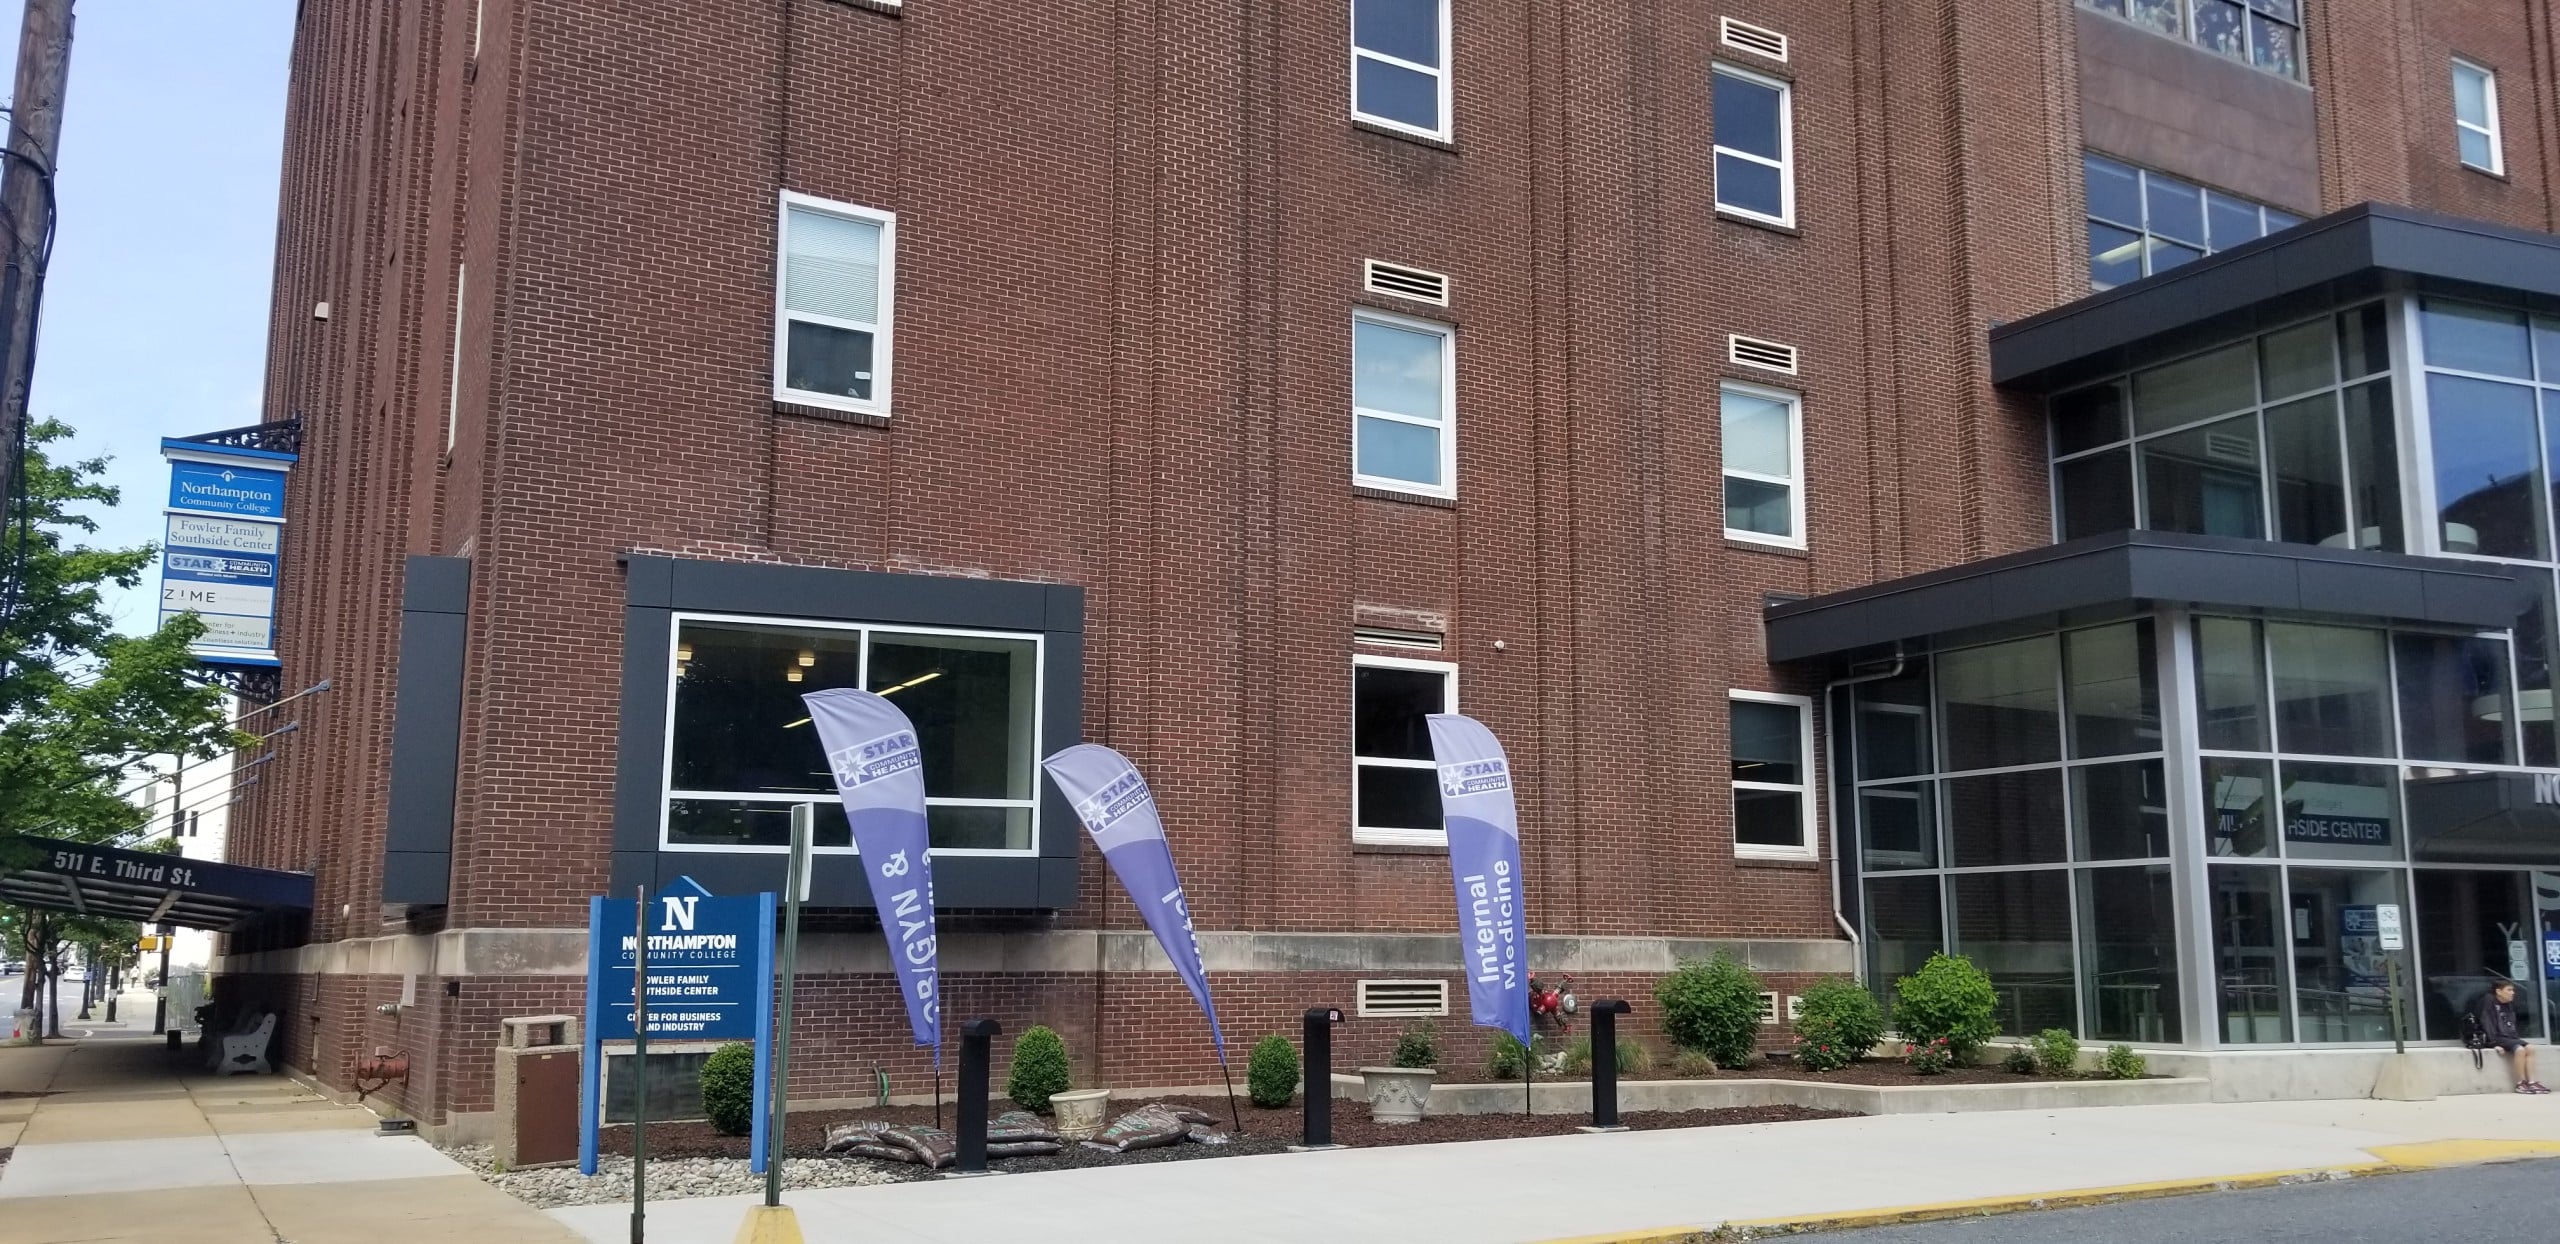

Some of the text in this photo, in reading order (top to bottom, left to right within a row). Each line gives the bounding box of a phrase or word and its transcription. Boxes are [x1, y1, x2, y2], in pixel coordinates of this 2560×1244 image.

[181, 481, 272, 502] Northampton
[180, 496, 271, 513] Community College
[180, 520, 265, 540] Fowler Family
[170, 531, 273, 551] Southside Center
[172, 556, 212, 569] STAR
[229, 565, 268, 574] HEALTH
[237, 629, 266, 639] industry
[864, 735, 912, 759] STAR
[870, 751, 917, 771] COMMUNITY
[871, 757, 919, 778] HEALTH
[1464, 762, 1503, 776] STAR
[1101, 774, 1138, 803] STAR
[1466, 776, 1505, 786] COMMUNITY
[1467, 781, 1506, 792] HEALTH
[1110, 786, 1145, 812] COMMUNITY
[1113, 791, 1149, 818] HEALTH
[2331, 821, 2382, 840] CENTER
[54, 851, 196, 887] 511 E. Third St.
[881, 848, 909, 877] &
[661, 896, 699, 931] N
[1463, 874, 1500, 983] Internal
[1493, 860, 1516, 990] Medicine
[622, 951, 736, 959] COUNITY COLLEGE
[677, 975, 709, 984] FAMILY
[684, 986, 718, 995] CENTER
[661, 1013, 678, 1021] FOR
[680, 1013, 721, 1021] BUSINESS
[663, 1022, 705, 1031] INDUSTRY
